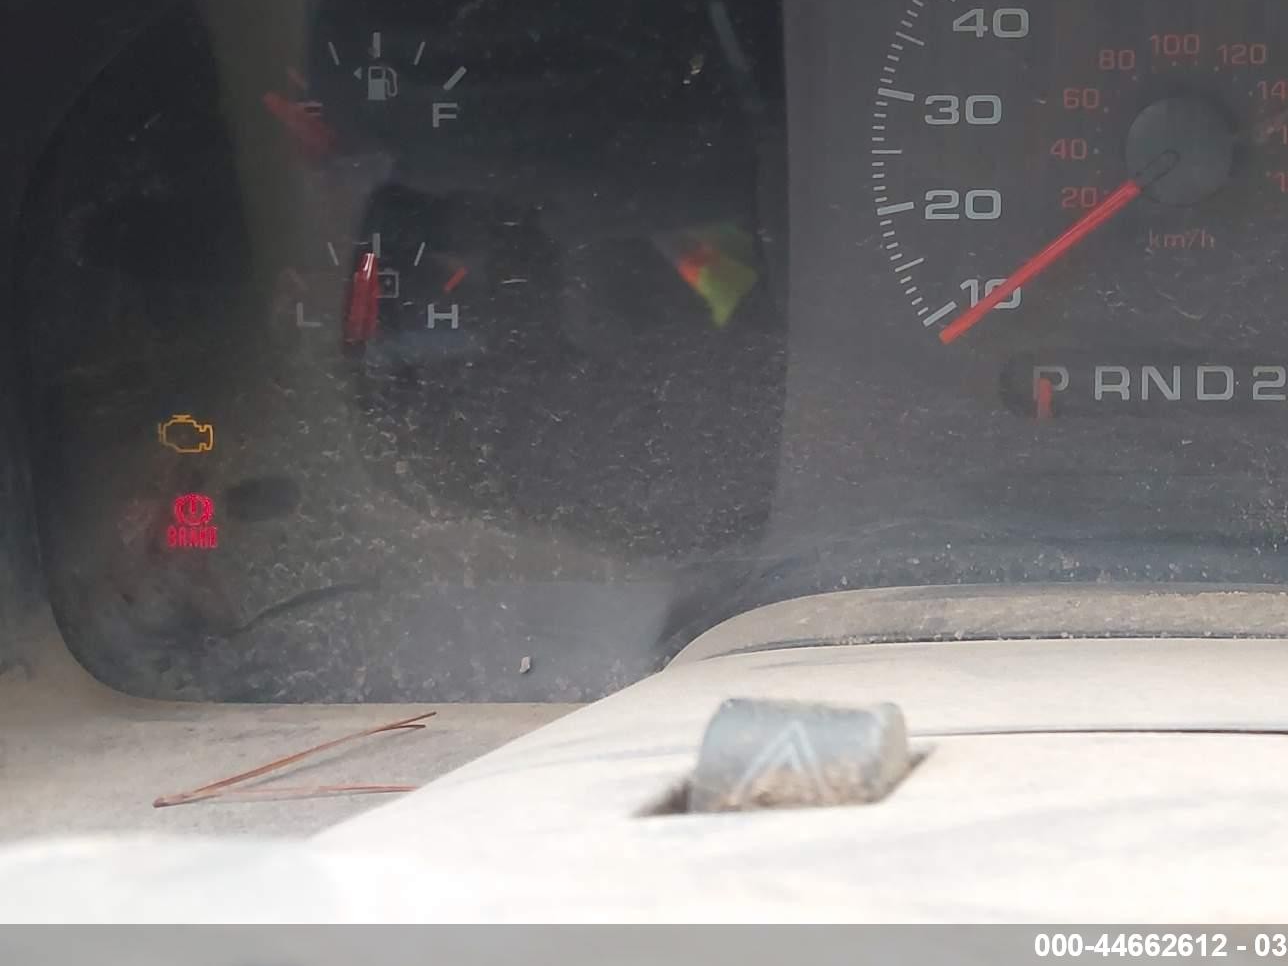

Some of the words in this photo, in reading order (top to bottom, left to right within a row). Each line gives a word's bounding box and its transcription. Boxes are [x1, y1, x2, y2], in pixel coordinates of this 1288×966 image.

[952, 8, 1030, 38] 40
[1150, 33, 1200, 55] 100
[1217, 43, 1267, 65] 120
[1100, 49, 1135, 70] 80
[924, 95, 1002, 125] 30
[1063, 88, 1099, 109] 60
[432, 102, 459, 128] F
[1050, 138, 1088, 160] 40
[924, 190, 1002, 220] 20
[1061, 186, 1098, 208] 20
[1149, 228, 1216, 249] km/h
[960, 279, 1021, 309] 10
[297, 302, 321, 328] L
[427, 304, 459, 329] H
[1033, 366, 1070, 401] P
